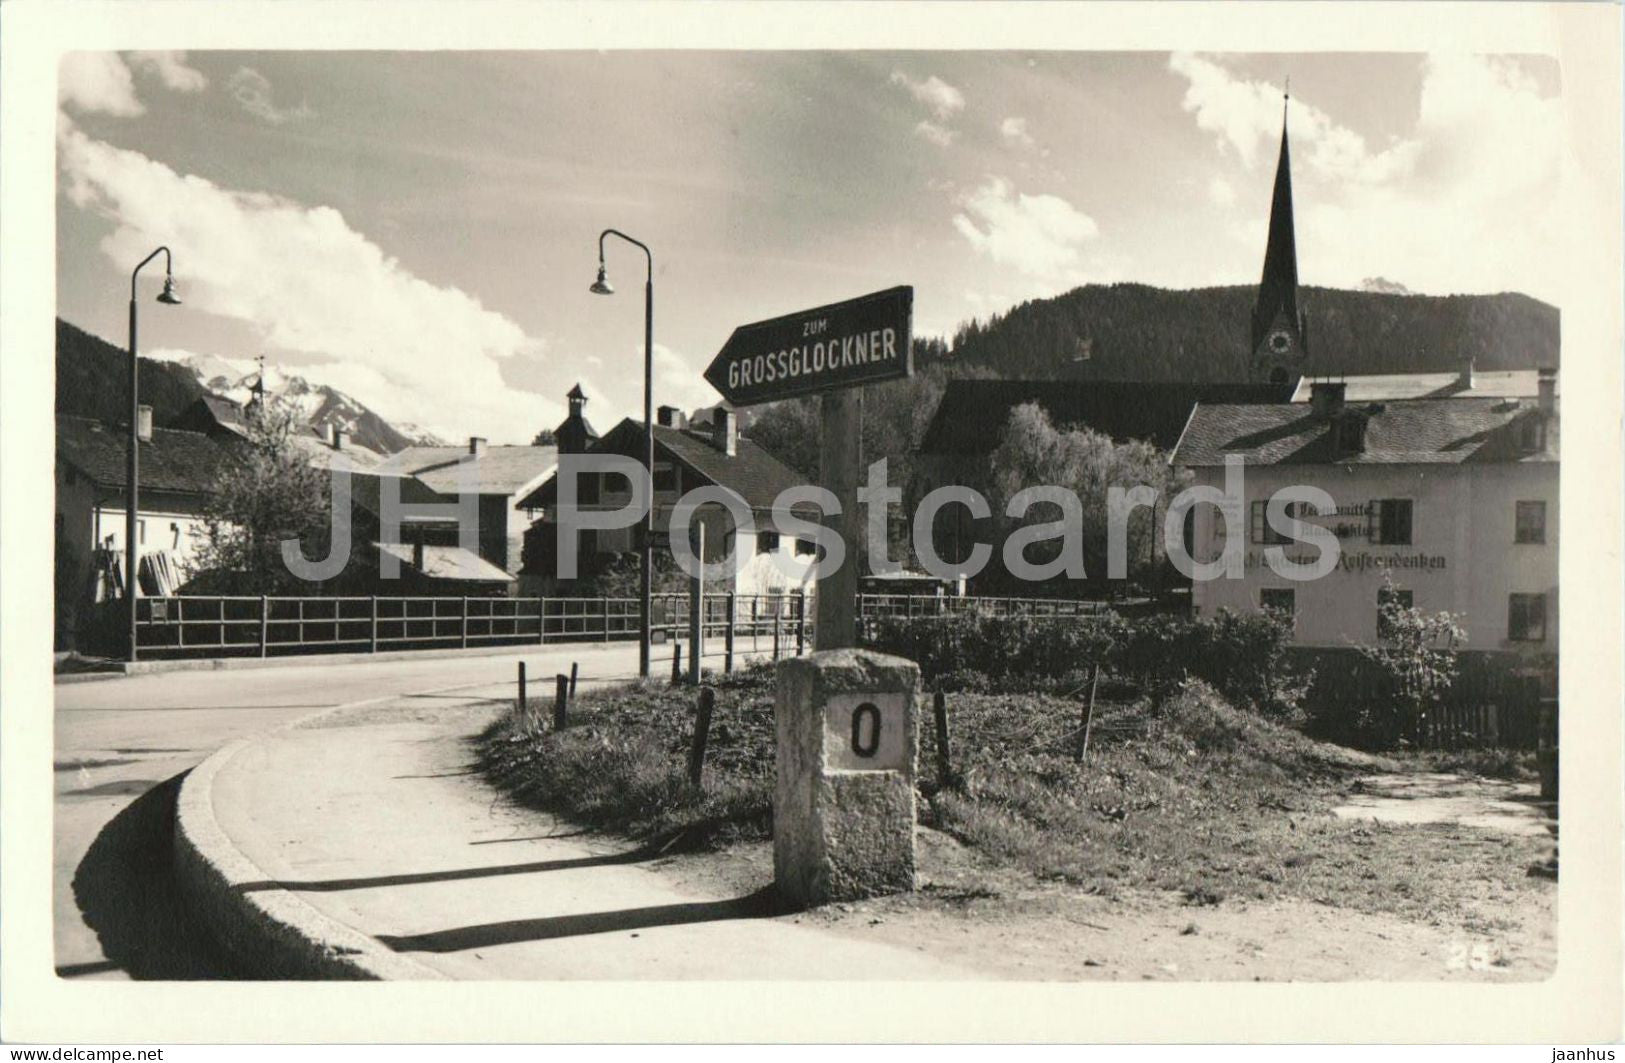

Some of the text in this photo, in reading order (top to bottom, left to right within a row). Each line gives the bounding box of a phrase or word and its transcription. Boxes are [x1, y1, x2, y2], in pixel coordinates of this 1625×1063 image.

[803, 318, 827, 337] ZUM
[729, 328, 896, 389] GROSSGLOCKNER
[851, 702, 881, 758] 0
